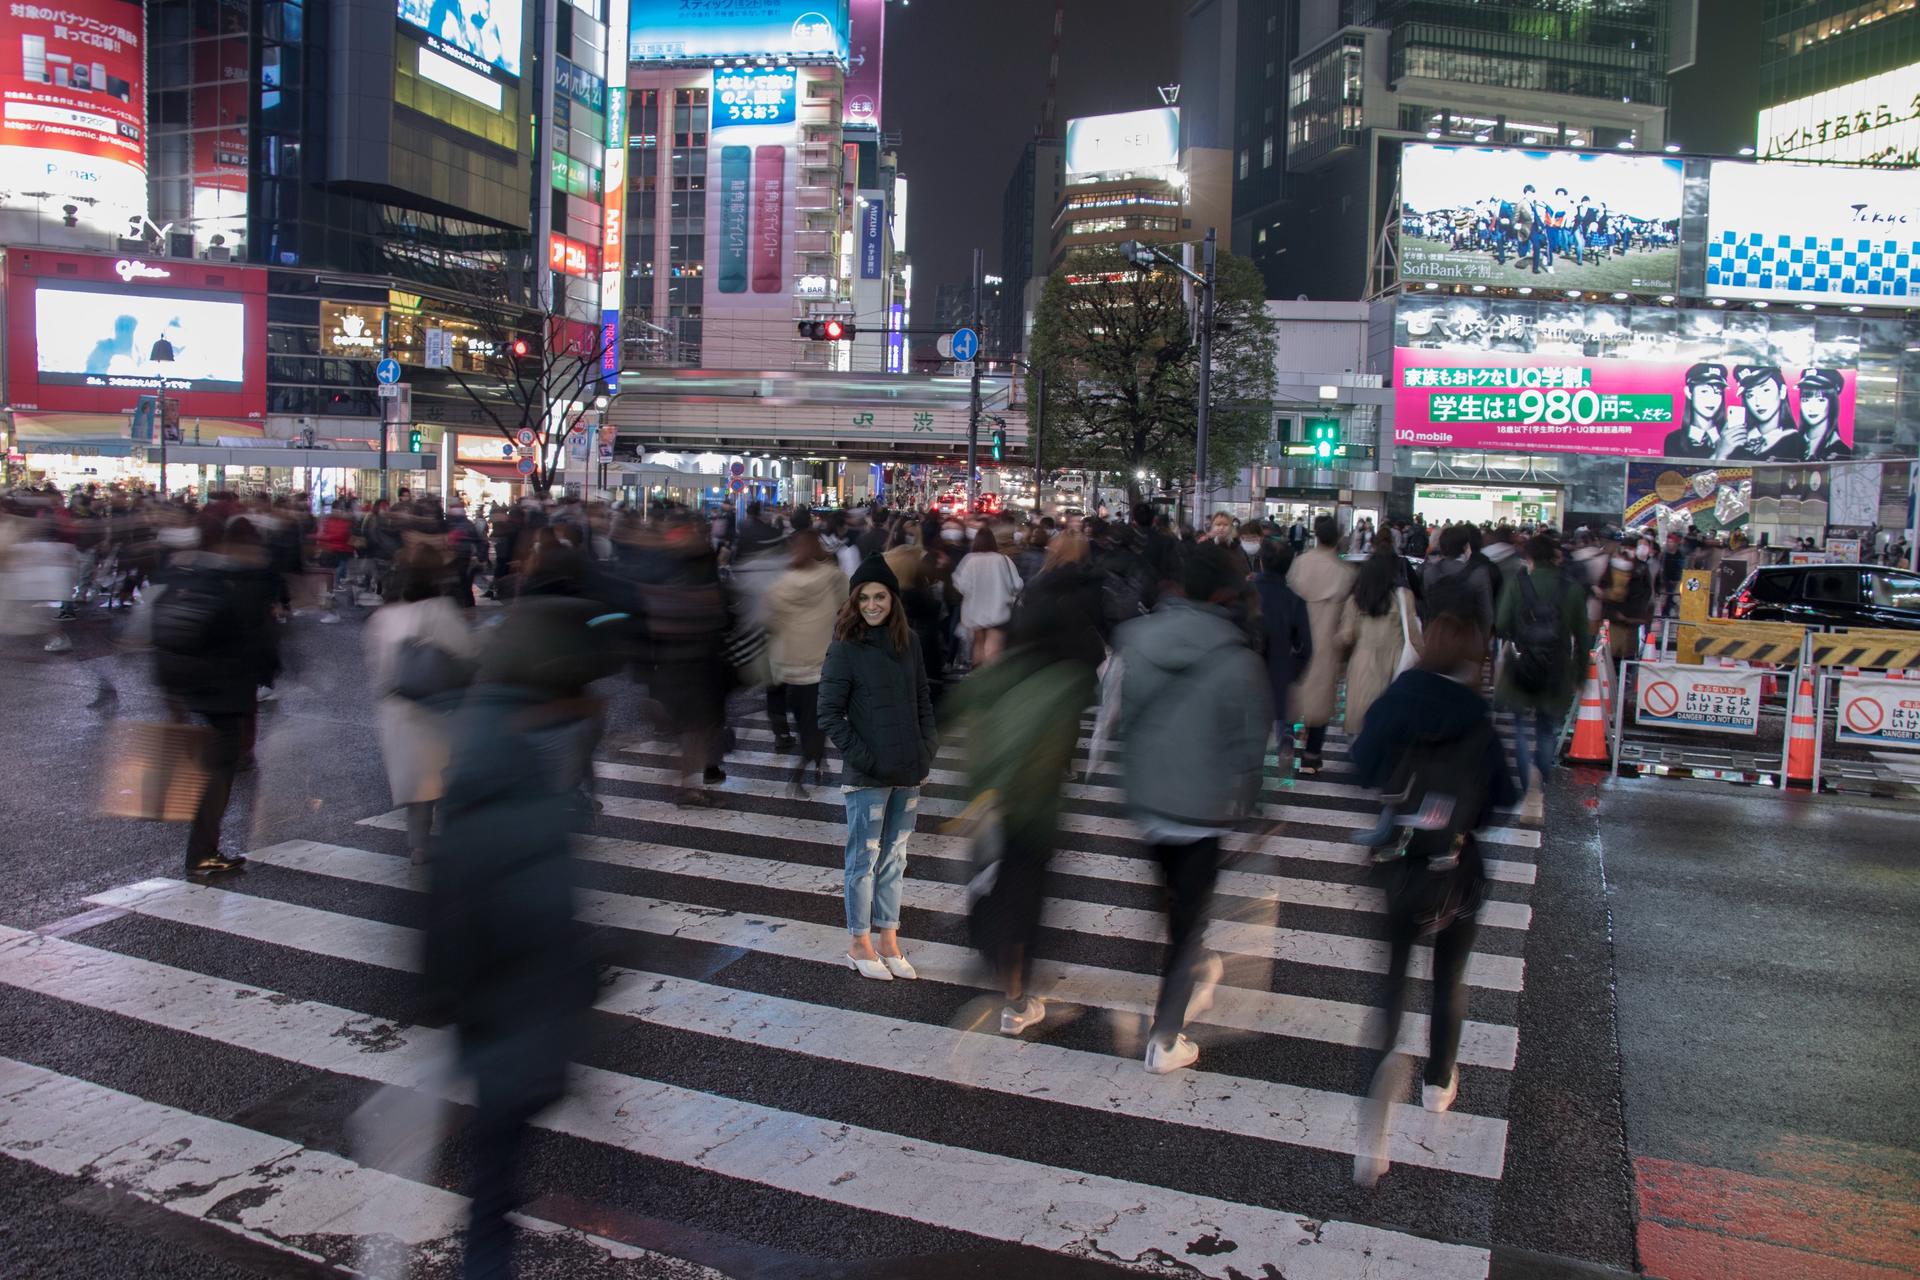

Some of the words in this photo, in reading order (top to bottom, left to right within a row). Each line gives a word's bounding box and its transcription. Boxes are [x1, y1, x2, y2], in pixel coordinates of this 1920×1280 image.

[728, 105, 780, 120] うるおう
[606, 208, 619, 245] アコム
[869, 205, 878, 237] MIZUHO
[553, 243, 586, 270] アコム
[1403, 260, 1463, 278] SoftBank
[1464, 264, 1491, 278] 学割
[853, 412, 874, 425] JR
[912, 411, 934, 432] 渋
[1395, 429, 1414, 443] UQ
[1416, 431, 1453, 443] mobile
[1524, 505, 1539, 513] JR
[1686, 692, 1751, 706] はいっては
[1686, 703, 1750, 716] いけません
[1892, 708, 1920, 719] はい
[1677, 712, 1705, 722] DANGER!
[1706, 714, 1716, 722] DO
[1717, 716, 1731, 724] NOT
[1732, 717, 1752, 726] ENTER
[1891, 719, 1918, 730] いけ
[1882, 729, 1913, 739] DANGER!
